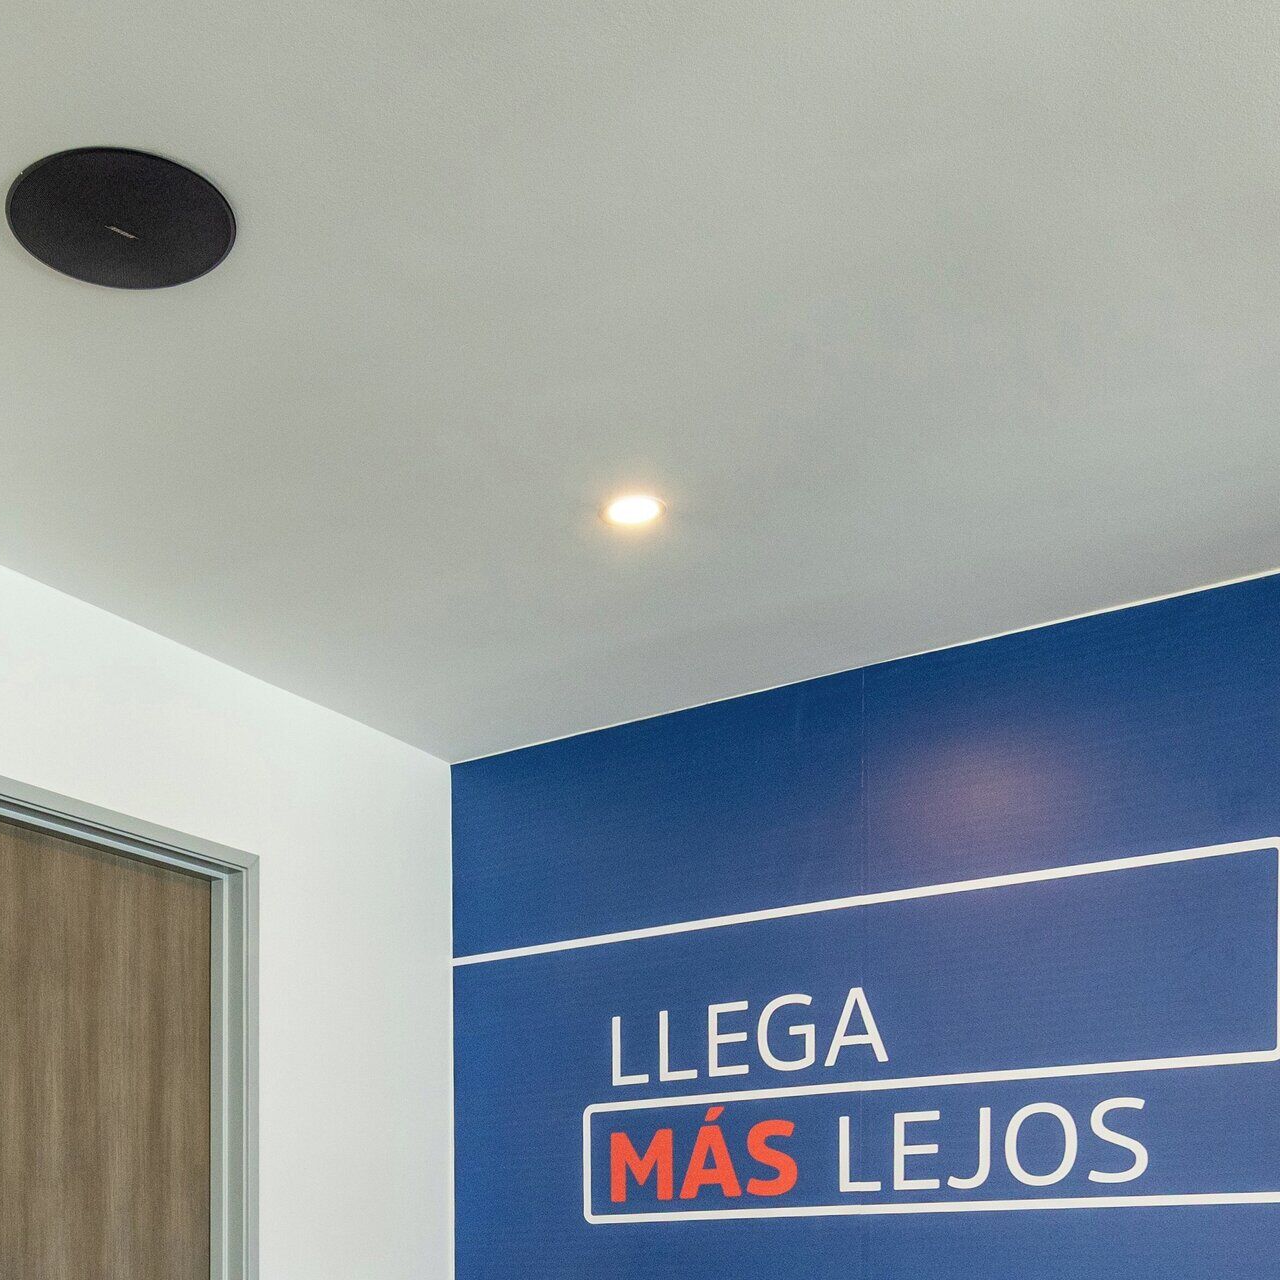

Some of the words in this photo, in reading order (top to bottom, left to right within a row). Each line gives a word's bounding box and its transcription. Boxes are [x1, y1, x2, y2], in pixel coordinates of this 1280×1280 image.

[610, 986, 889, 1087] LLEGA
[609, 1106, 799, 1203] MÁS
[837, 1097, 1150, 1193] LEJOS
